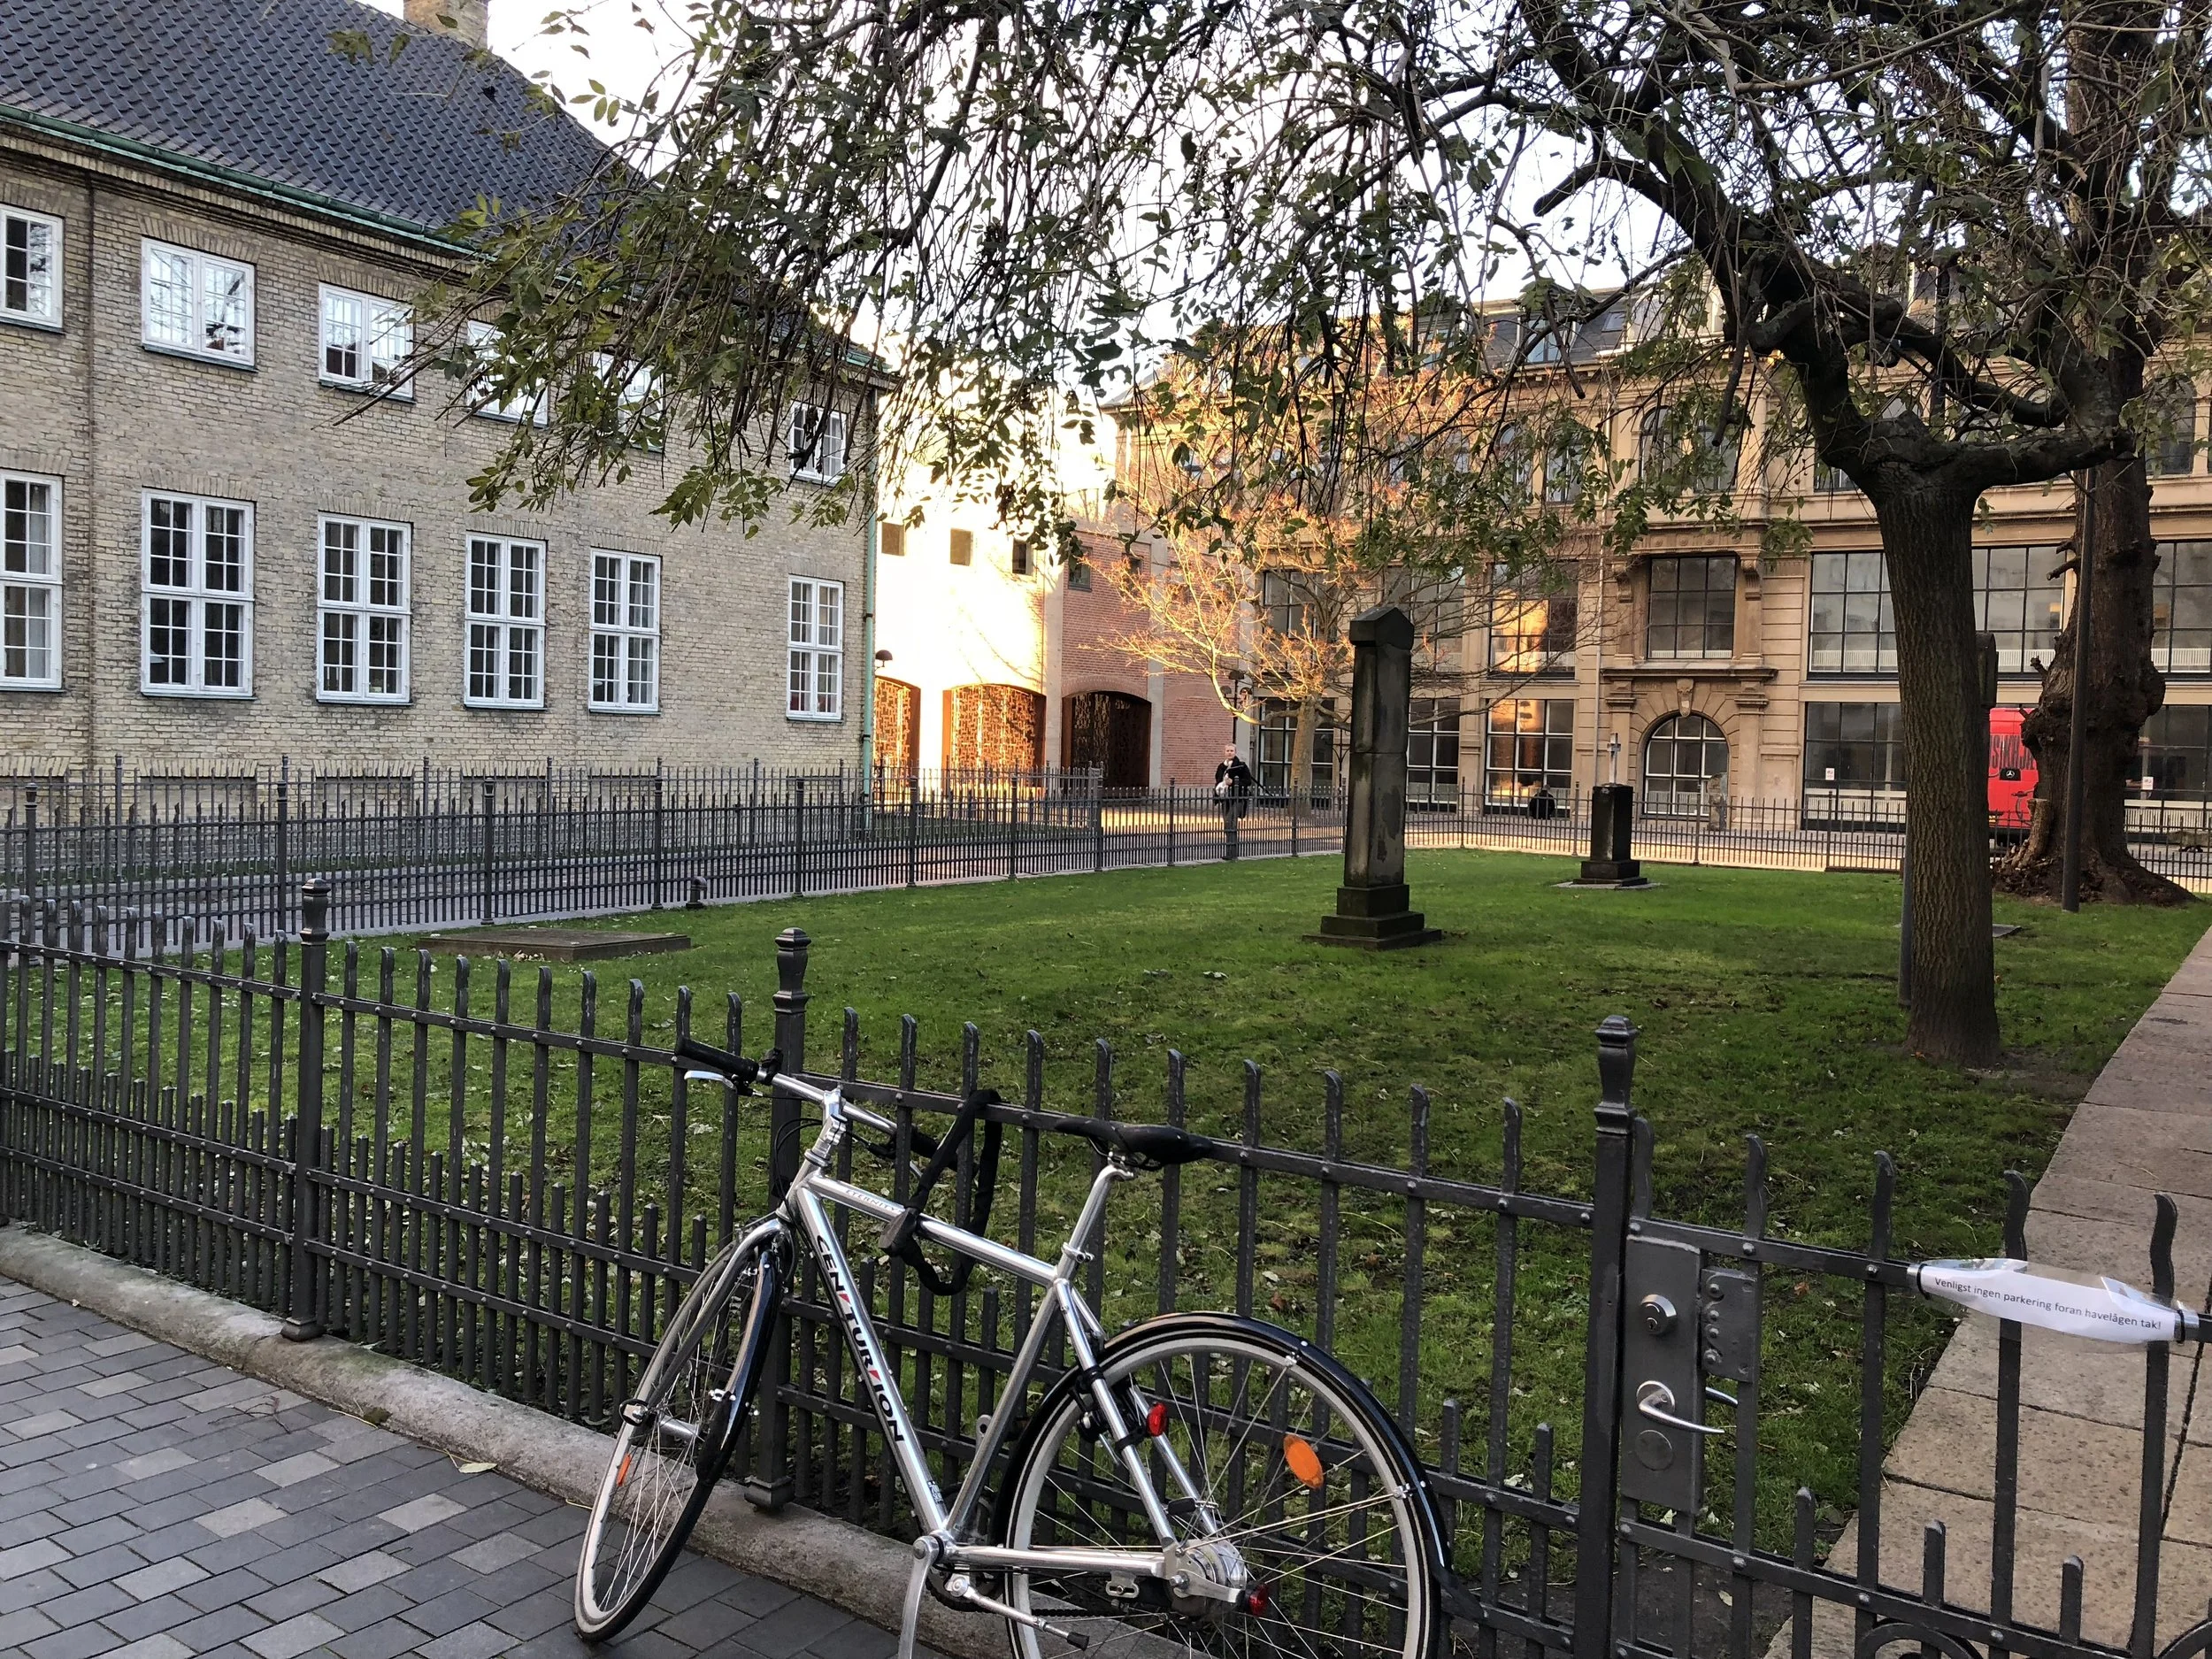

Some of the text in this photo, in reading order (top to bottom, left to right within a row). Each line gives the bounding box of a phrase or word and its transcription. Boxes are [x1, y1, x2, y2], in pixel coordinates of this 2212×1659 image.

[846, 1189, 896, 1210] ETERNITY
[1934, 1277, 2162, 1330] Venligst ingen parkering foran havelågen tak!
[816, 1234, 905, 1443] CENTURION
